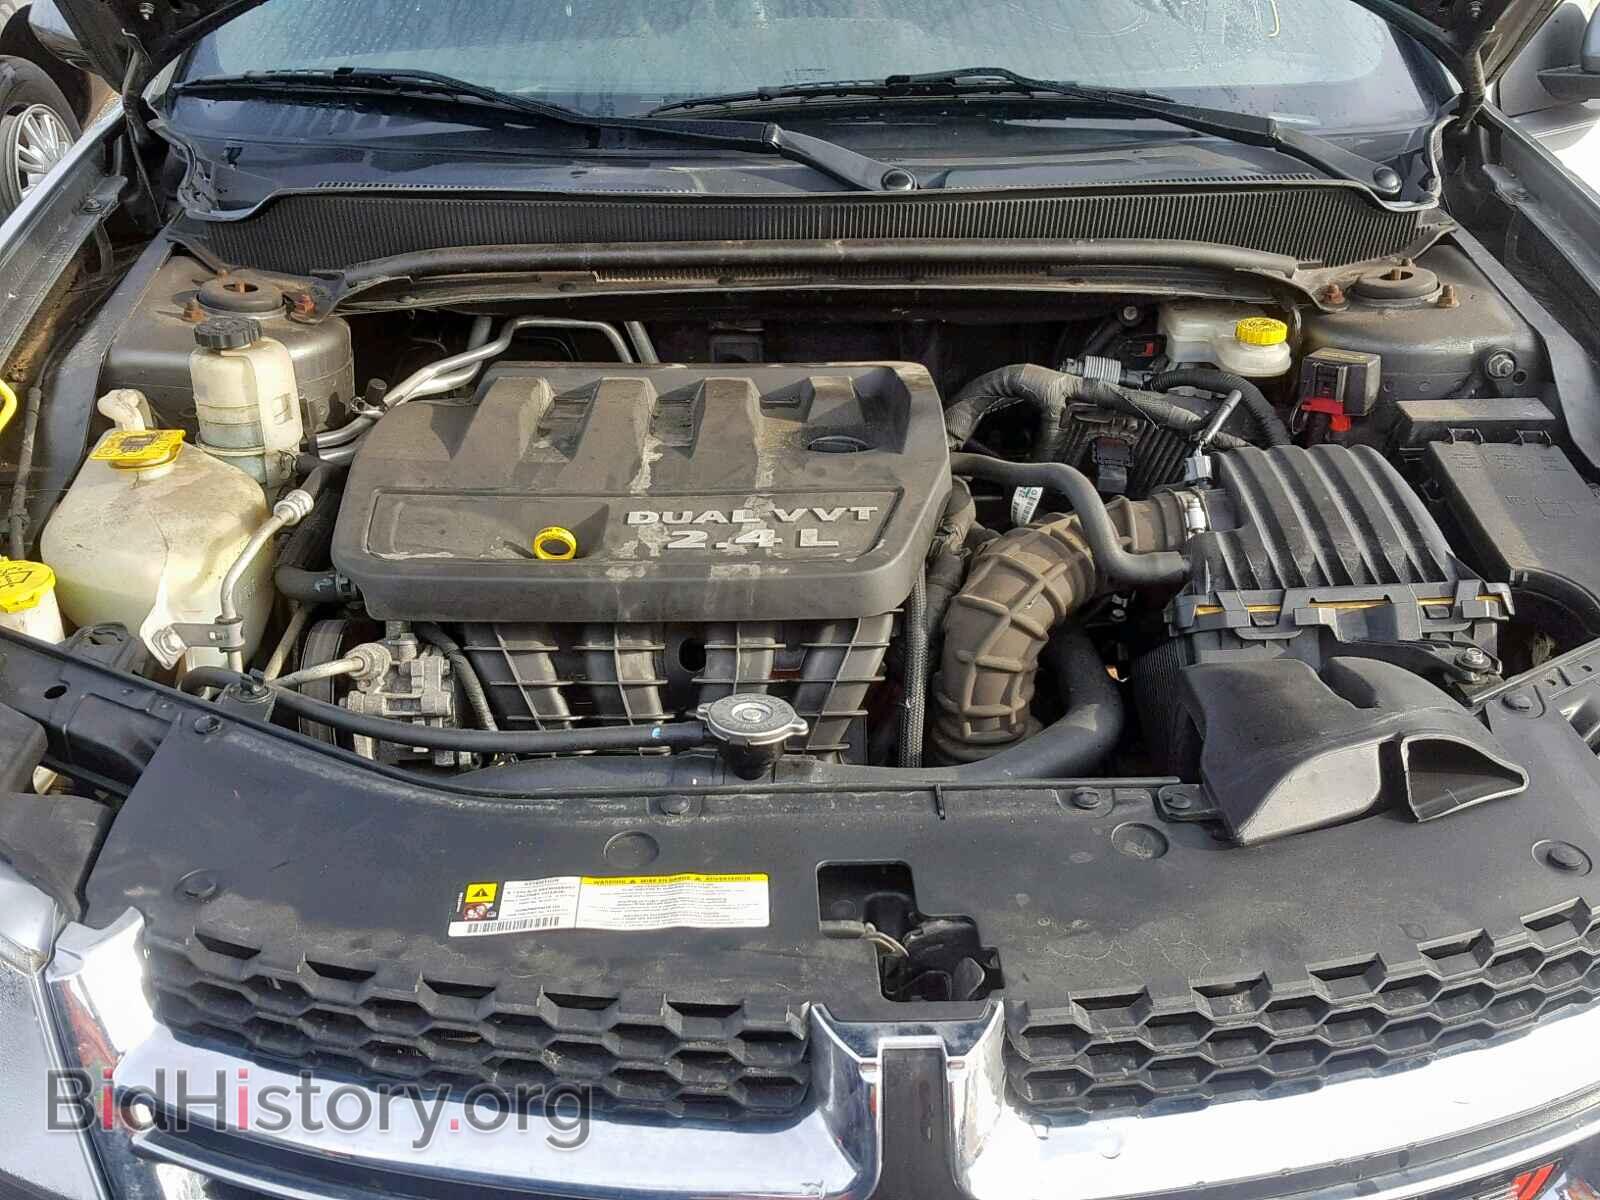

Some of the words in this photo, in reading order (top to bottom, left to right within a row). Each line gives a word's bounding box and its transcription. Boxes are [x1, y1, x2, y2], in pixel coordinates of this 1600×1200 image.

[627, 510, 761, 525] DUAL
[772, 506, 879, 523] VVT
[666, 529, 783, 549] 2.4
[800, 527, 840, 548] L
